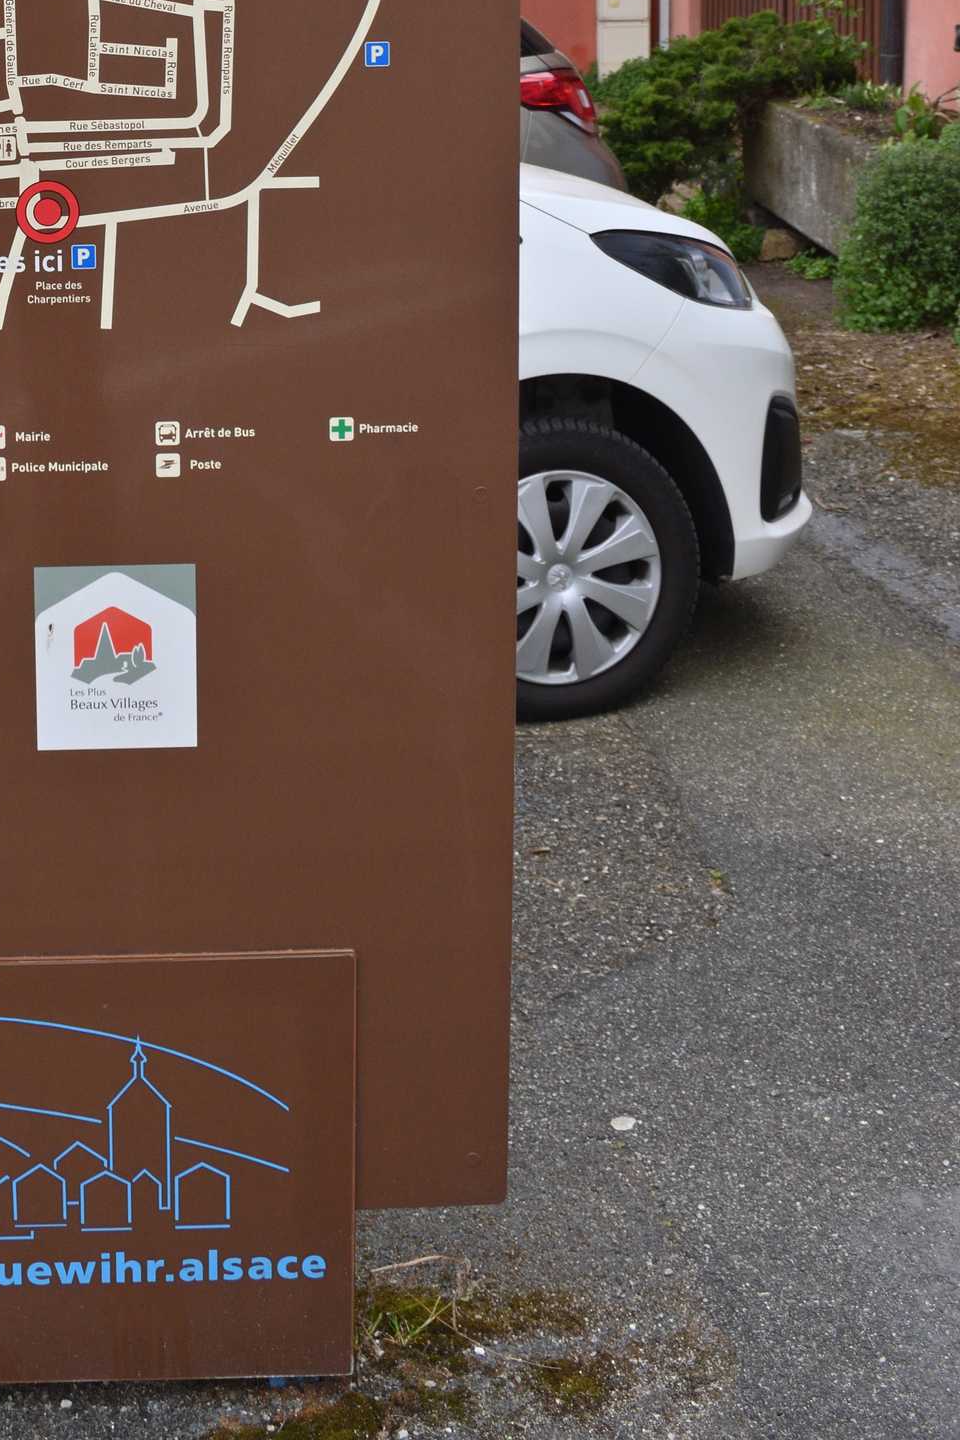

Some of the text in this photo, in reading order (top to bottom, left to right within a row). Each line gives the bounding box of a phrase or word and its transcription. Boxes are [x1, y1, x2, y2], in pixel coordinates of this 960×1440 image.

[144, 0, 176, 12] Cheval
[5, 0, 15, 39] Général
[224, 5, 232, 24] Rue
[90, 15, 98, 33] Rue
[7, 41, 14, 52] de
[101, 44, 174, 58] Saint Nicolas
[7, 55, 15, 86] Gaulle
[167, 62, 176, 83] Rue
[223, 47, 231, 94] Remparts
[22, 76, 84, 89] Rue du Cerf
[101, 84, 172, 98] Saint Nicolas
[70, 122, 88, 130] Rue
[105, 140, 152, 150] Remparts
[66, 156, 151, 168] Cour des Bergers
[184, 201, 219, 213] Avenue
[34, 250, 63, 272] ici
[36, 281, 82, 290] Place des
[27, 294, 90, 304] Charpentiers
[185, 427, 255, 439] Arrêt de Bus
[359, 422, 418, 434] Pharmacie
[15, 432, 50, 442] Mairie
[12, 461, 108, 474] Police Municipale
[190, 460, 221, 470] Poste
[71, 688, 106, 697] Les Plus
[70, 698, 157, 710] Beaux Villages
[114, 713, 125, 721] de
